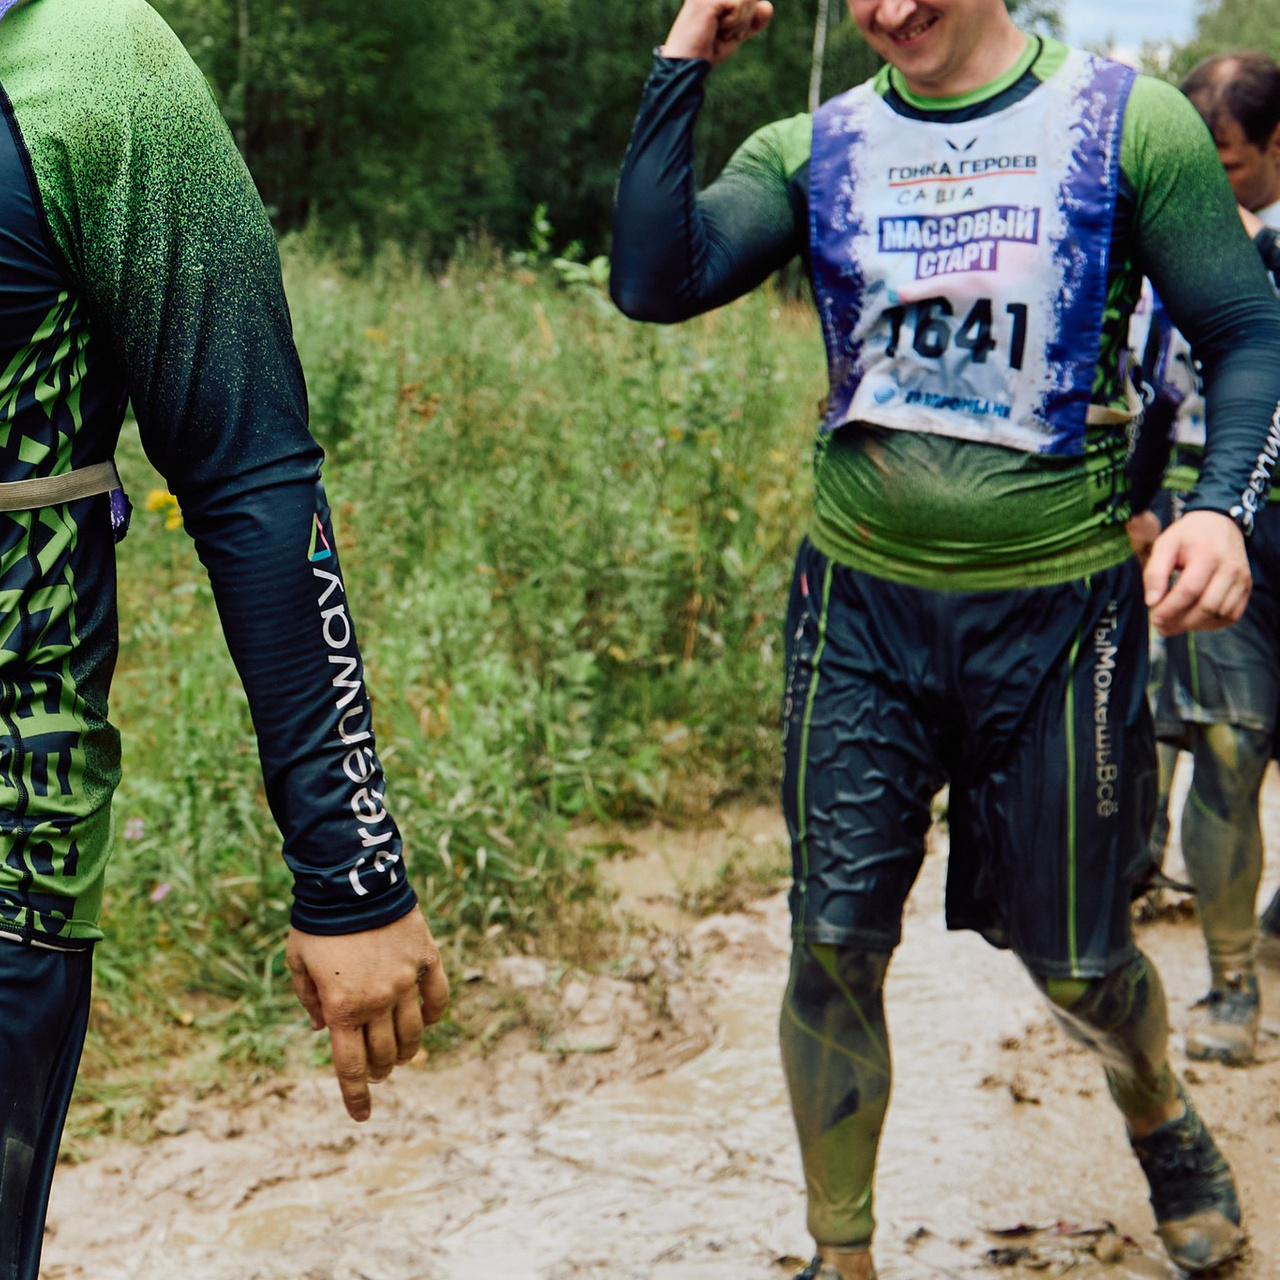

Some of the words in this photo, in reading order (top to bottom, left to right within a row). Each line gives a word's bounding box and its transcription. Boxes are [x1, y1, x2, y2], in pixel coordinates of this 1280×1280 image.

[888, 162, 951, 180] ГОНКА
[959, 155, 1037, 173] ГЕРОЕВ
[882, 205, 1036, 250] МАССОВЫЙ
[918, 240, 995, 278] СТАРТ
[881, 296, 1028, 370] 1641
[312, 567, 401, 897] Greenway
